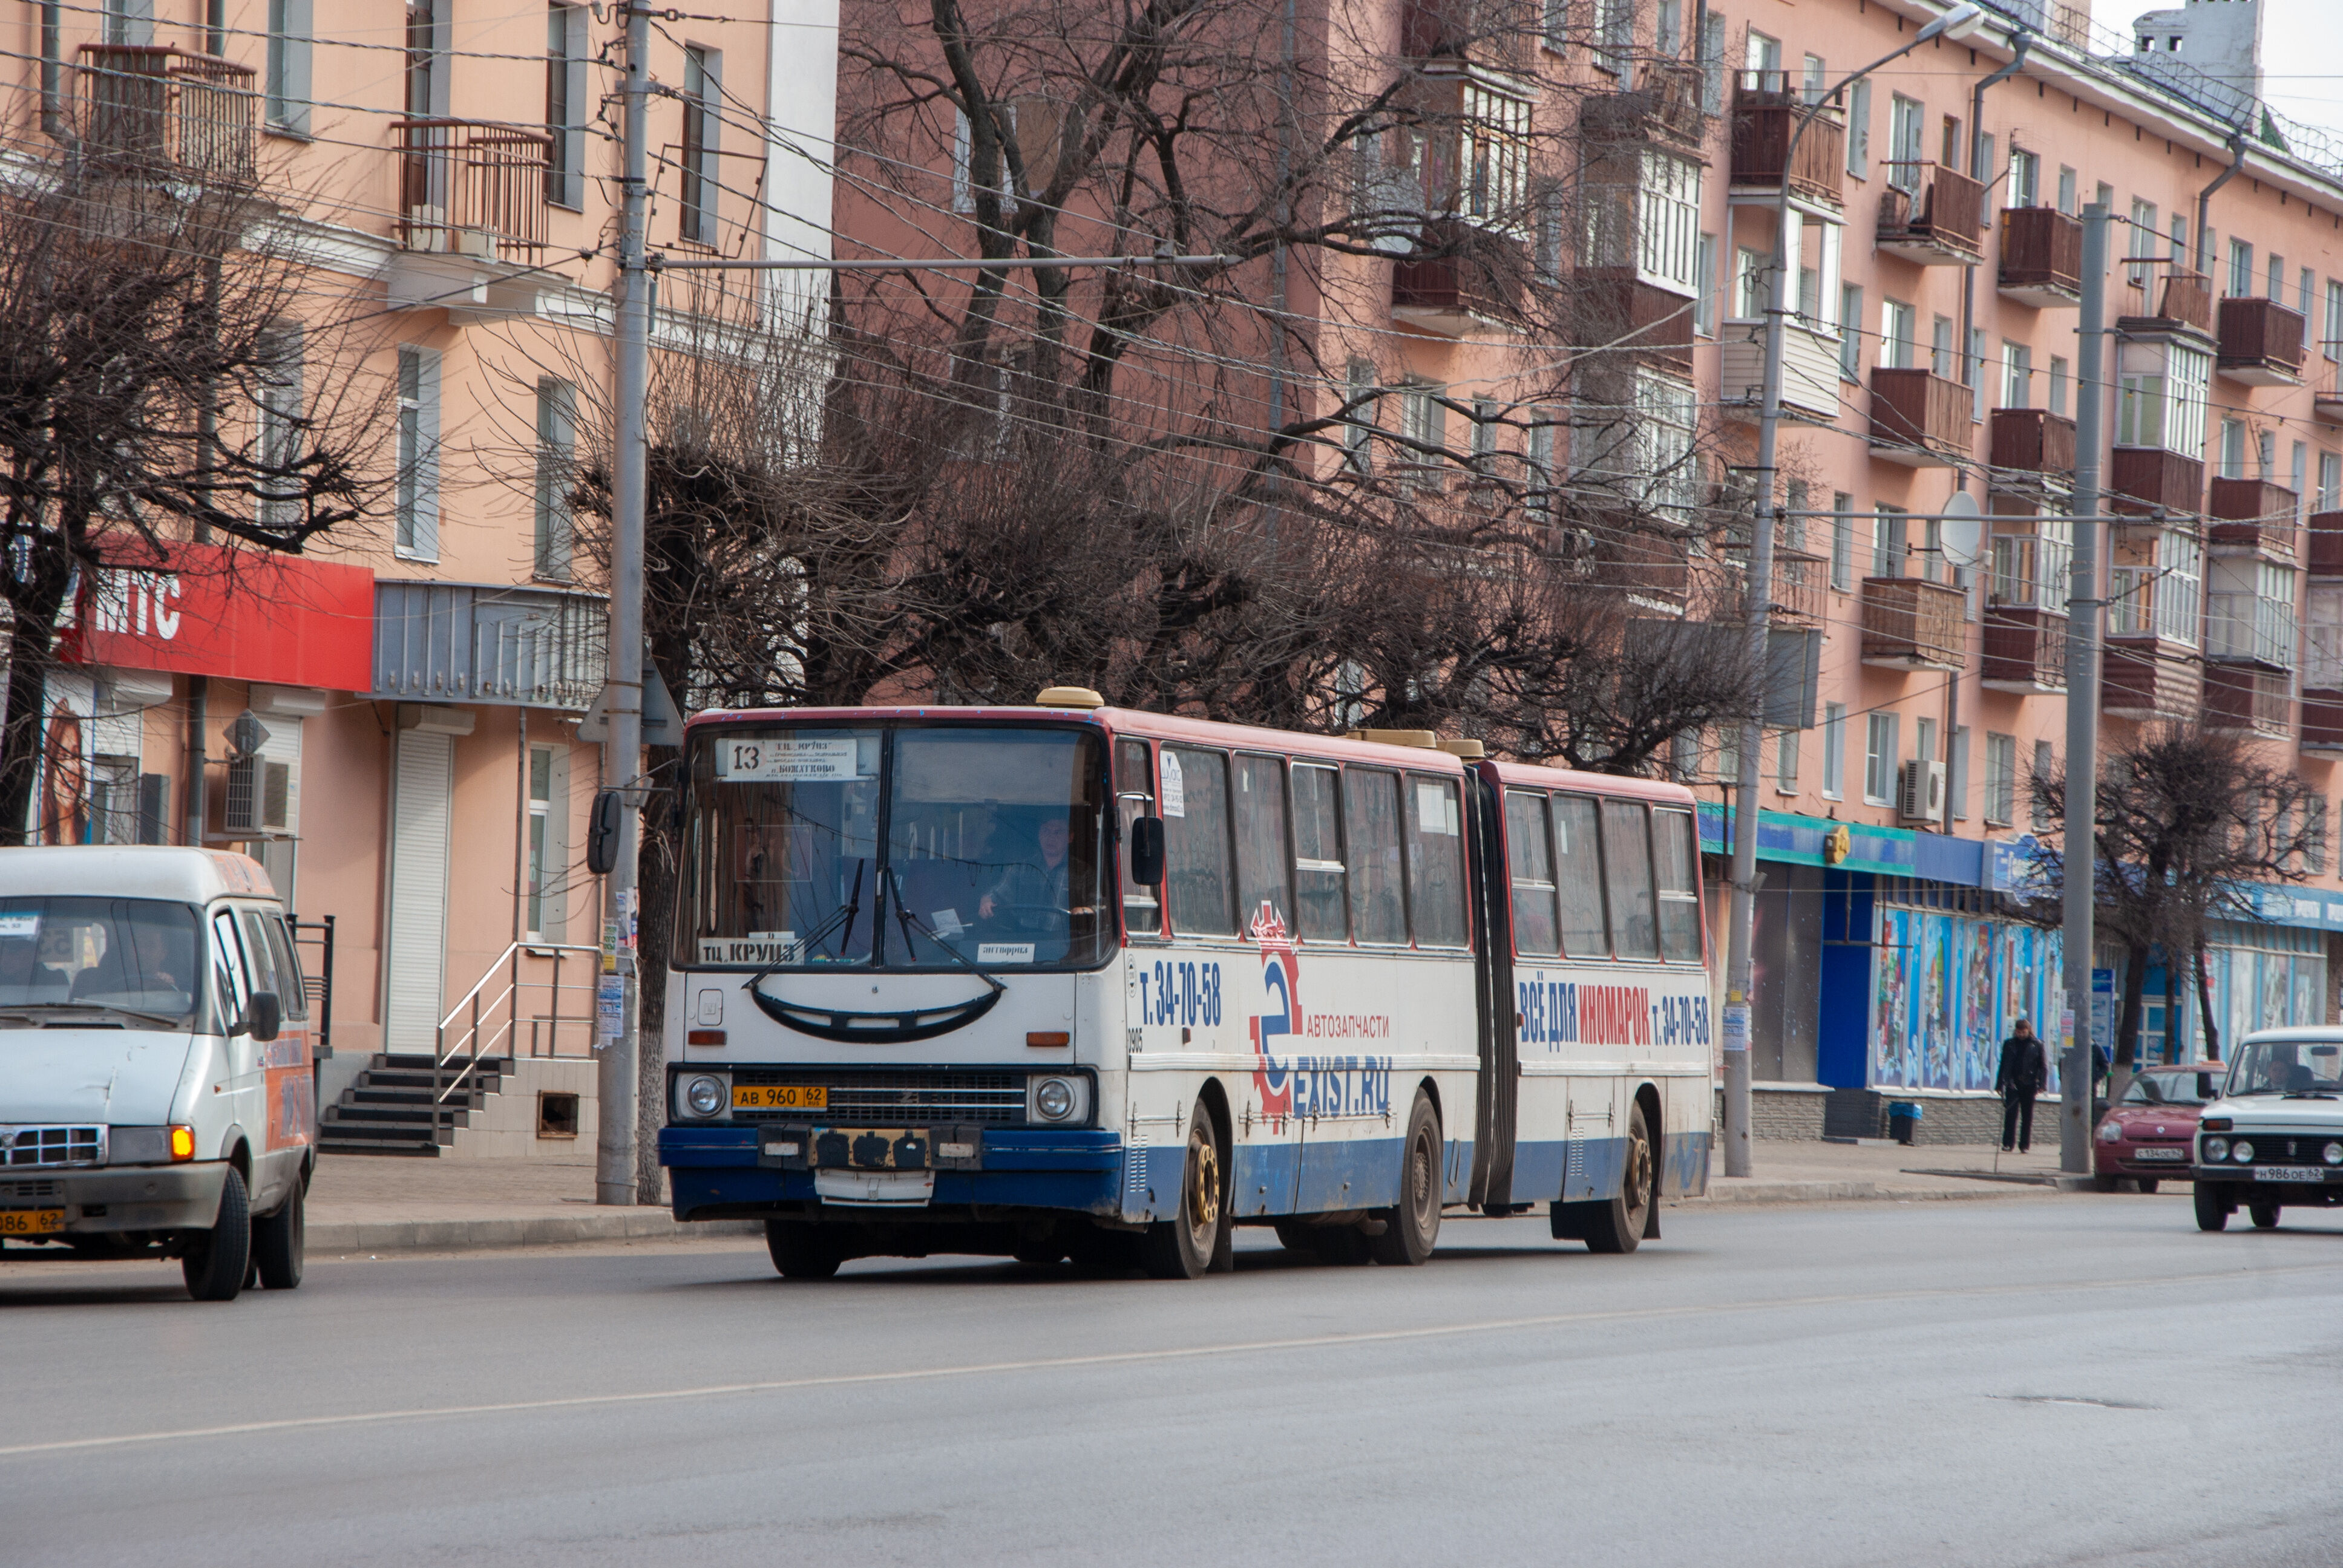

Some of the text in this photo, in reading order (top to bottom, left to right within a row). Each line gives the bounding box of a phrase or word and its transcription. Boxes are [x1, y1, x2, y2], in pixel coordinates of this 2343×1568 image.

[96, 569, 180, 640] МТС
[734, 745, 759, 770] 13
[703, 947, 723, 963] ТЦ
[1155, 960, 1221, 1027] 34-70-58
[1519, 971, 1546, 1043] ВСЁ
[1549, 982, 1577, 1053] ДЛЯ
[1579, 985, 1651, 1045] ИНОМАРОК
[1663, 996, 1709, 1045] 34-70-58
[1307, 1014, 1390, 1038] АВТОЗАПЧАСТИ
[767, 1089, 796, 1105] 960
[806, 1088, 822, 1100] 62
[1294, 1056, 1392, 1119] EXIST.RU
[40, 1213, 58, 1226] 62
